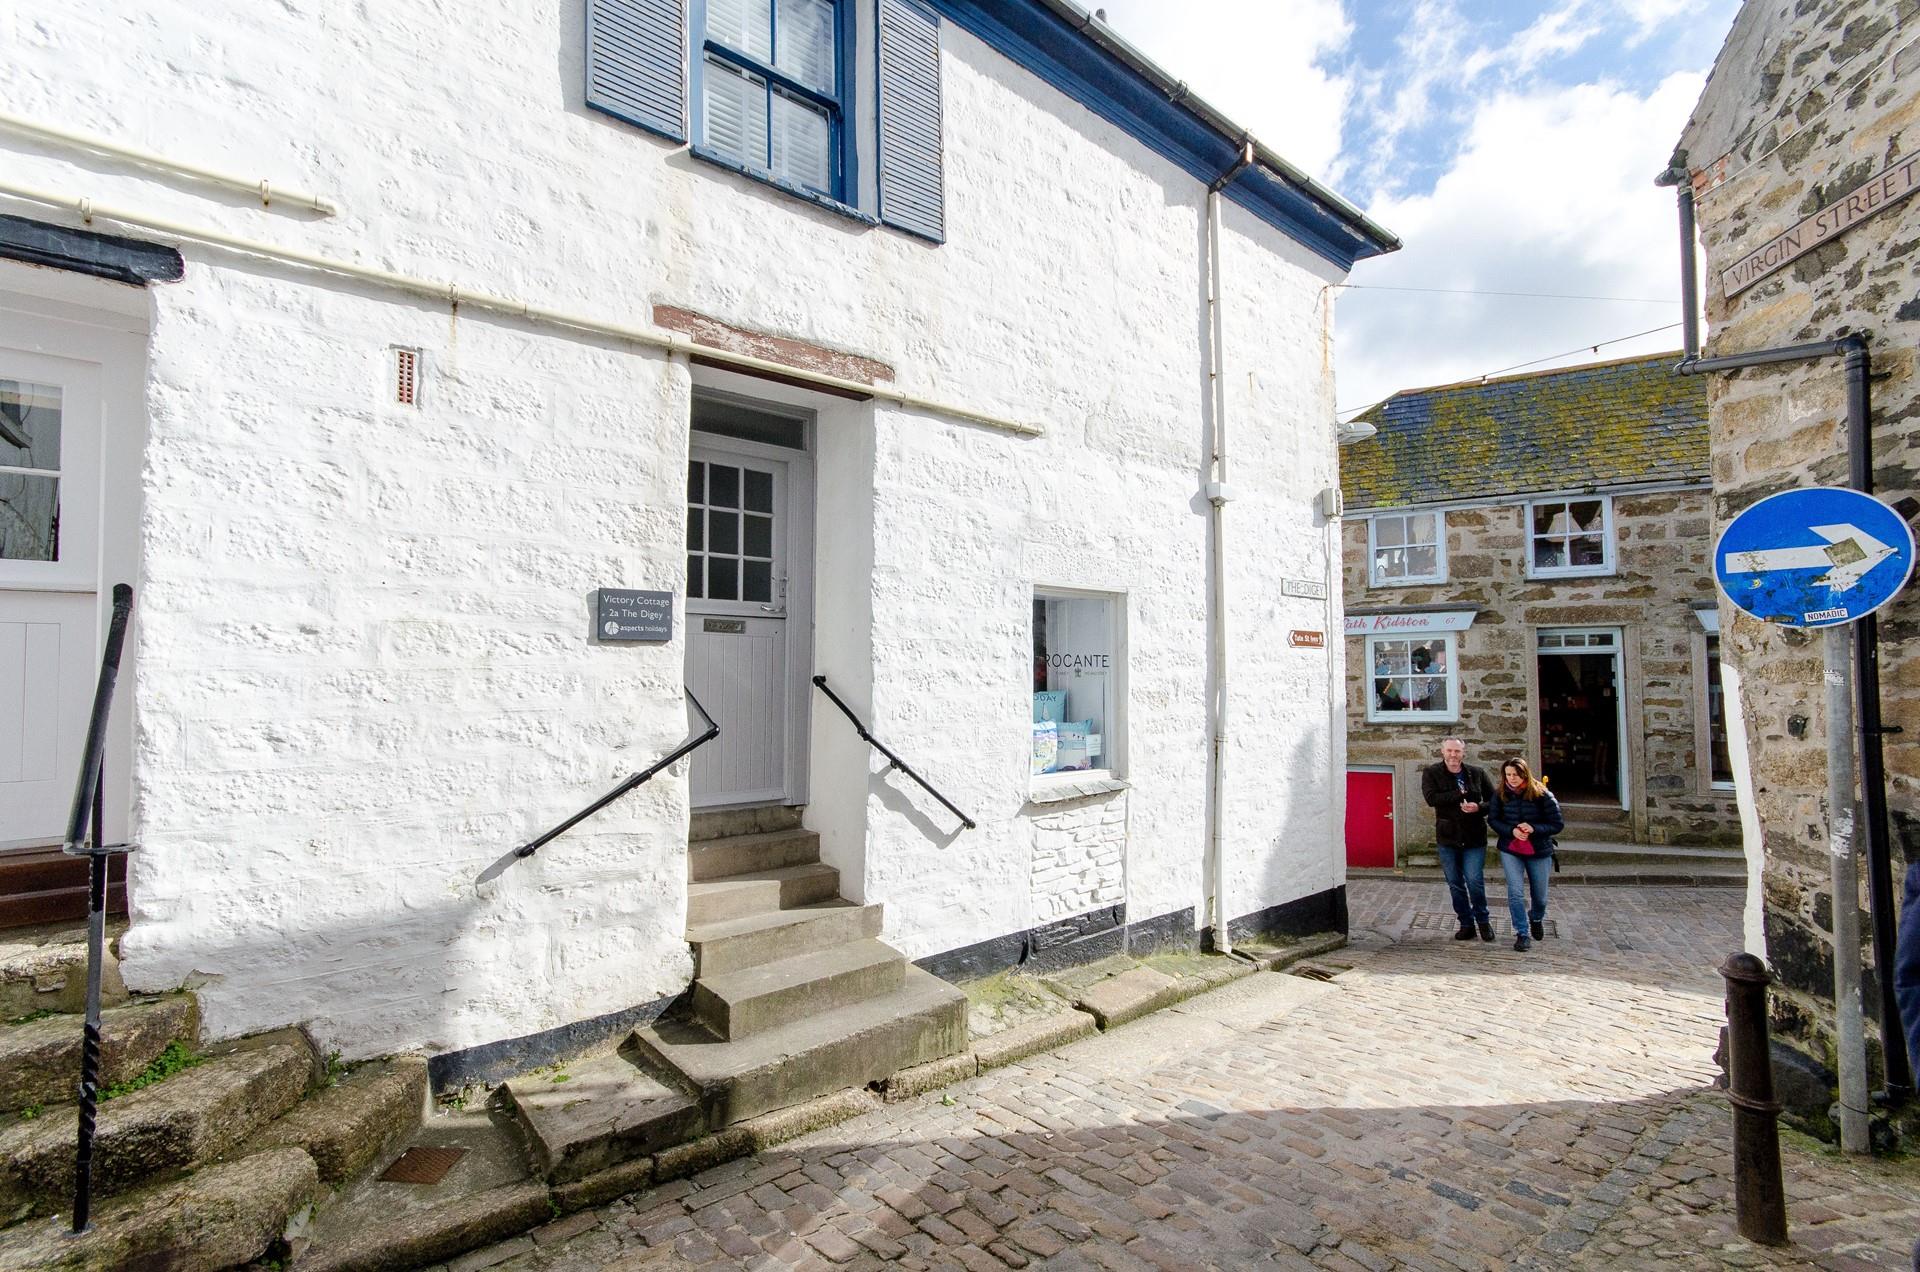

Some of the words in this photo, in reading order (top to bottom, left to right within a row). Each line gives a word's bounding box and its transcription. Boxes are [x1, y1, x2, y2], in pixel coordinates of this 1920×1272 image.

[1732, 229, 1802, 286] VIRGIN
[1815, 159, 1919, 238] STREET
[1286, 581, 1301, 594] THE
[603, 594, 635, 606] Victory
[636, 596, 670, 608] Cottage
[609, 608, 619, 617] 2a
[621, 608, 638, 618] The
[640, 609, 663, 621] Digey
[1807, 609, 1846, 621] NOMADIC
[644, 625, 668, 633] holidays
[1373, 614, 1430, 631] Kidston
[1045, 653, 1110, 668] ROCANTE
